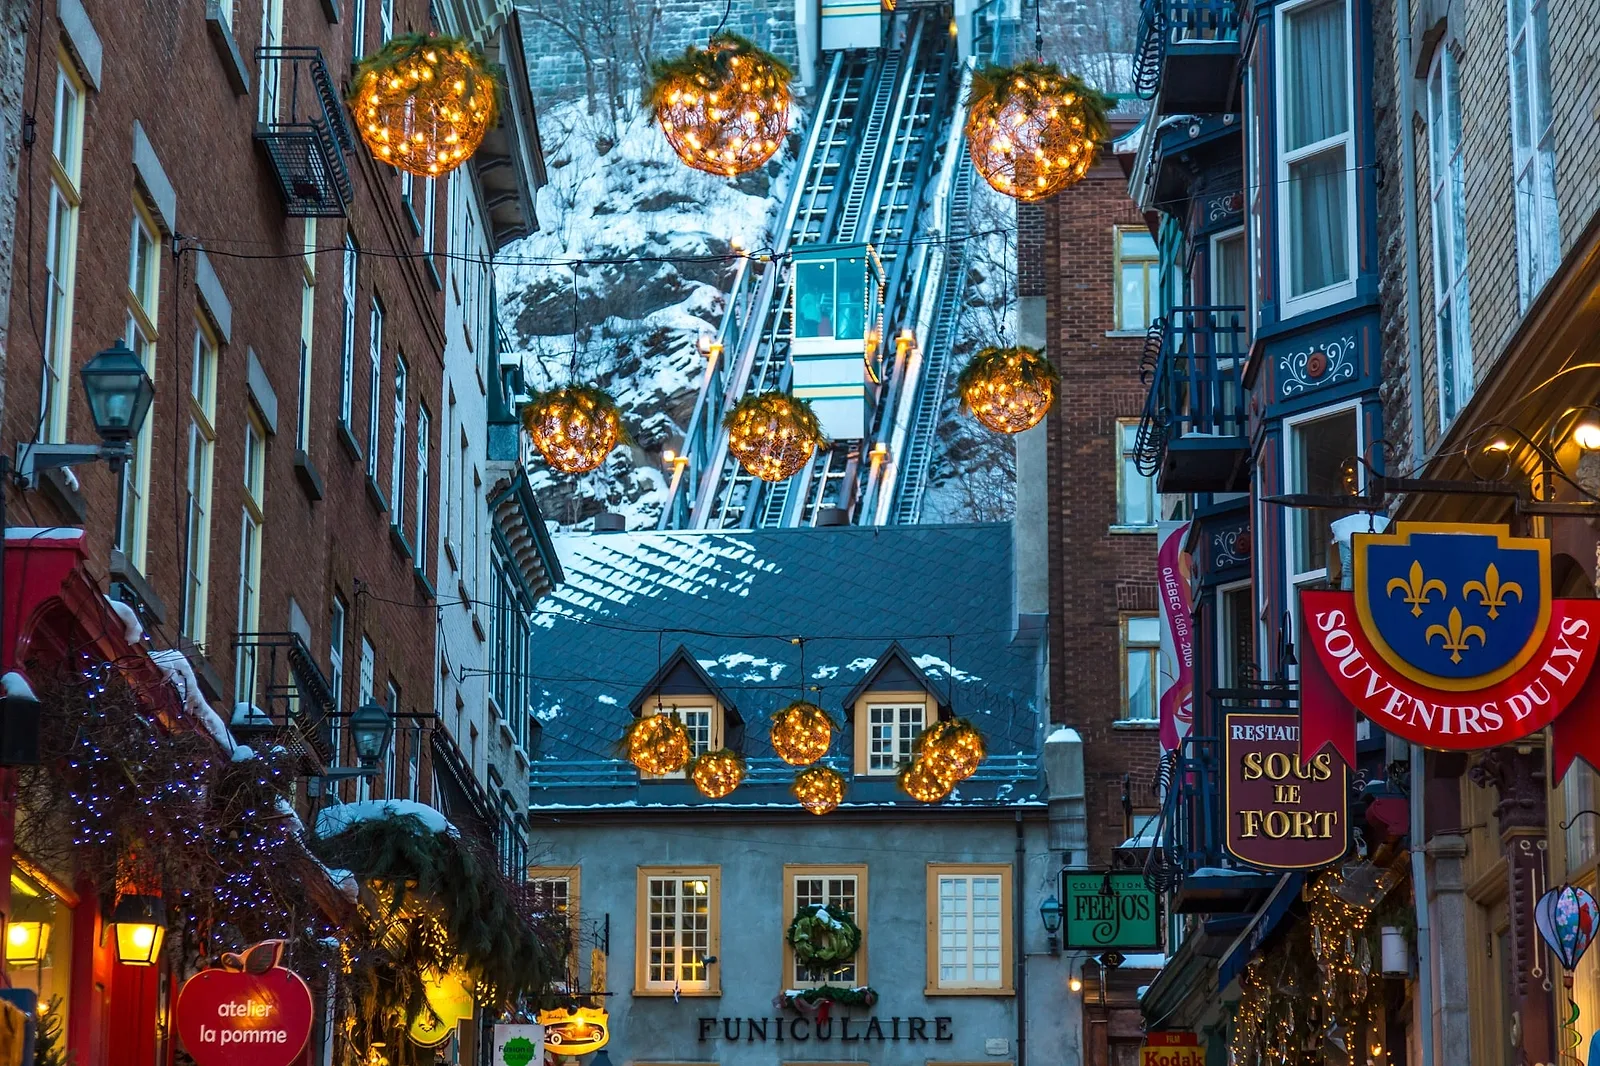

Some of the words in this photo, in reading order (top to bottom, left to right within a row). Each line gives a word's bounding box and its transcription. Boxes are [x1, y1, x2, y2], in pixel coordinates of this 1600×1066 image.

[1162, 567, 1181, 610] QUÉBEC
[1174, 613, 1188, 637] 1608
[1316, 609, 1504, 734] SOUVENIRS
[1505, 678, 1551, 721] DU
[1541, 616, 1590, 687] LYS
[1244, 751, 1331, 781] SOUS
[1274, 784, 1301, 804] LE
[1240, 810, 1338, 838] FORT
[1108, 954, 1118, 965] 52
[218, 1000, 273, 1017] atelier
[200, 1024, 216, 1042] la
[220, 1029, 287, 1046] pomme
[698, 1016, 953, 1042] FUNICULAIRE
[1166, 1035, 1180, 1043] FILM
[1144, 1051, 1204, 1066] Kodak
